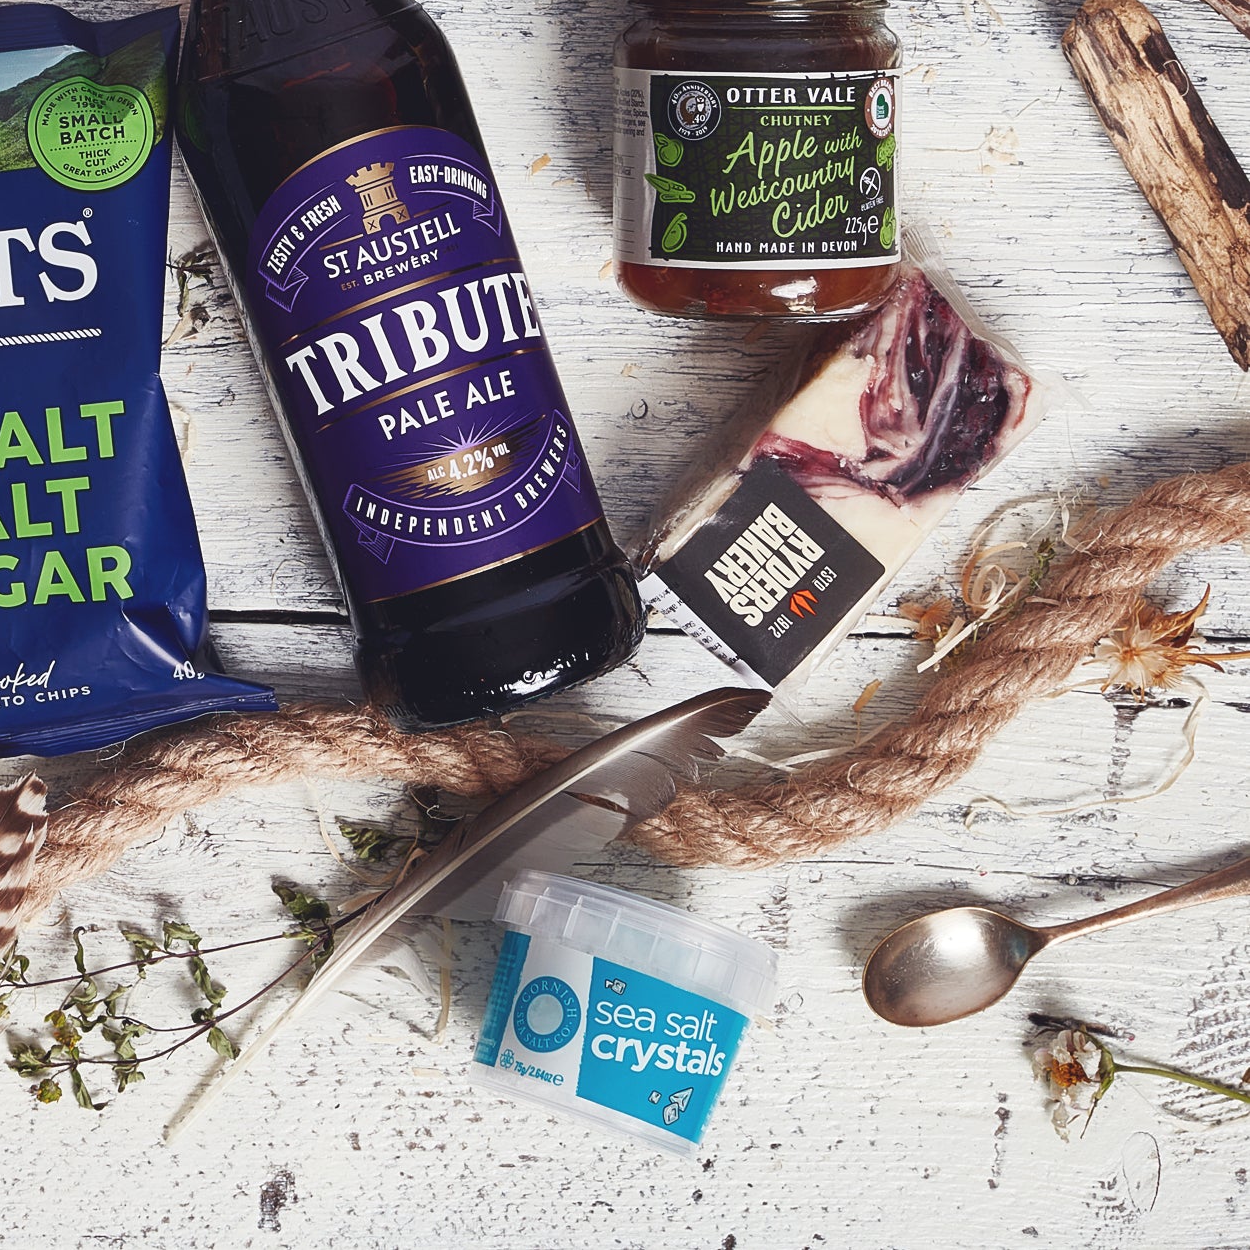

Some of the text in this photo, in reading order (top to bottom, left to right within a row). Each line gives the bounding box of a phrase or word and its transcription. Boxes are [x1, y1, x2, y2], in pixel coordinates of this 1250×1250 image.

[726, 87, 798, 104] OTTER
[807, 87, 856, 103] VALE
[59, 114, 123, 129] SMALL
[60, 126, 125, 146] BATCH
[760, 114, 832, 127] CHUTNEY
[63, 155, 130, 177] GREAT CRUNCH
[79, 149, 111, 159] THICK
[85, 158, 106, 168] CUT
[722, 126, 863, 178] Apple with
[409, 165, 487, 199] EASY-DRINKING
[710, 155, 855, 218] Westcountry
[772, 192, 849, 238] Cider
[267, 195, 342, 274] ZESTY & FRESH
[356, 212, 461, 270] AUSTELL
[716, 240, 857, 253] HAND MADE IN DEVON
[341, 280, 360, 291] EST.
[286, 272, 541, 417] TRIBUTE
[377, 370, 516, 441] PALE ALE
[356, 425, 567, 536] INDEPENDENT BREWERS
[427, 442, 510, 481] ALC 4.2% VOL
[704, 502, 798, 605] BAKERY
[729, 529, 826, 627] RYDERS
[767, 614, 794, 639] 1972
[35, 685, 92, 703] CHIPS
[522, 980, 577, 1018] CORNISH
[595, 1000, 717, 1042] sea salt
[591, 1033, 726, 1077] crystals
